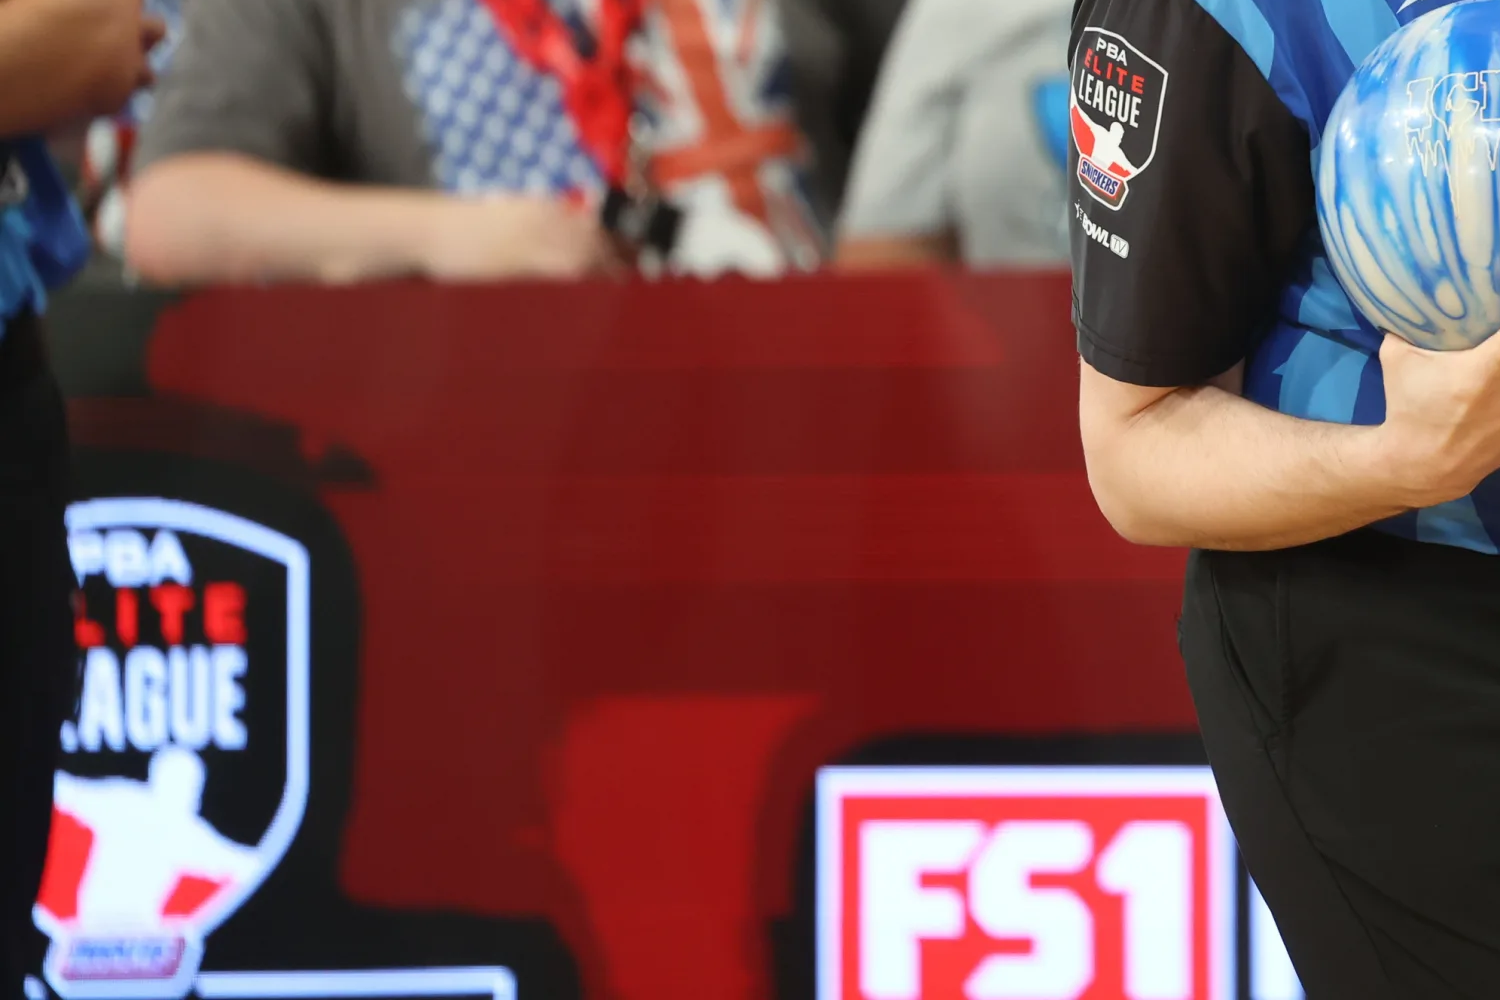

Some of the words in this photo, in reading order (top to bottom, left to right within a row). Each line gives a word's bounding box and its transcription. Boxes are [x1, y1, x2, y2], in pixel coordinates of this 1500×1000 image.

[1084, 47, 1144, 95] ELITE
[1096, 37, 1127, 66] PBA
[1078, 68, 1142, 128] LEAGUE
[1081, 160, 1118, 196] SNICKERS
[67, 529, 193, 588] PBA
[74, 581, 247, 649] LITE
[60, 645, 248, 752] AGUE
[858, 818, 1194, 1000] FS1
